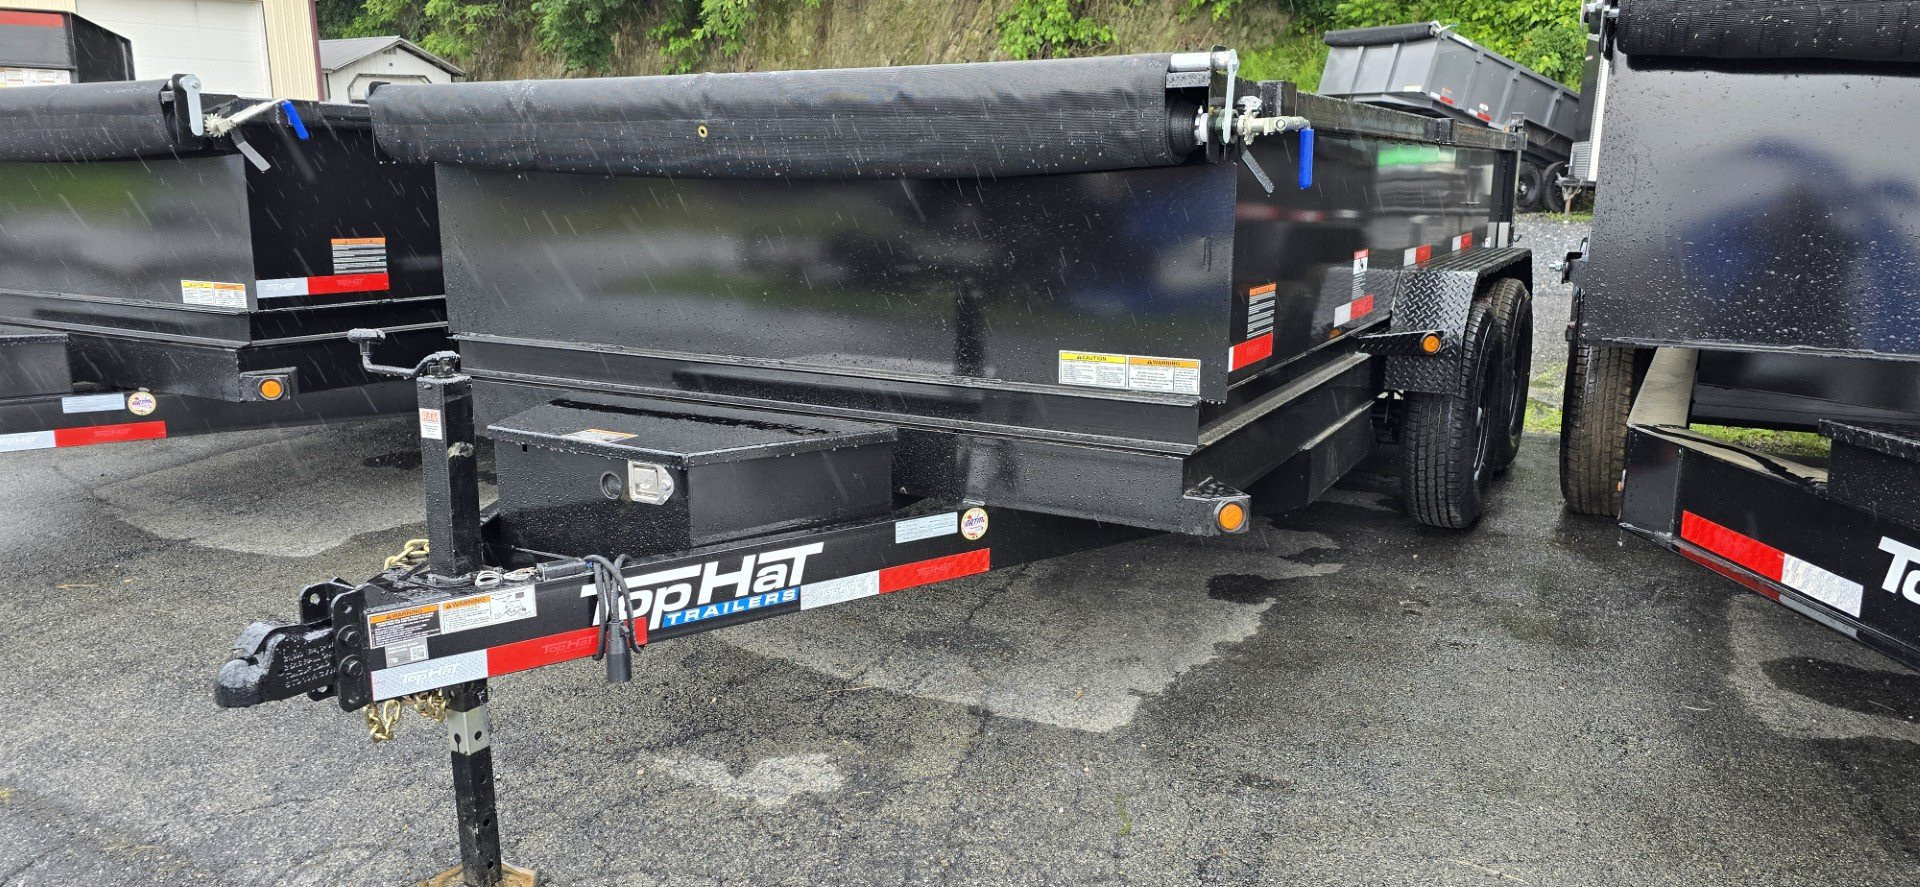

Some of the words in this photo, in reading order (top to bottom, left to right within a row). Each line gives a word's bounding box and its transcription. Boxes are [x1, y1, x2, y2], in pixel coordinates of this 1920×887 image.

[452, 596, 486, 609] WARNING
[667, 588, 797, 624] TRAILERS
[392, 609, 423, 619] WARNING
